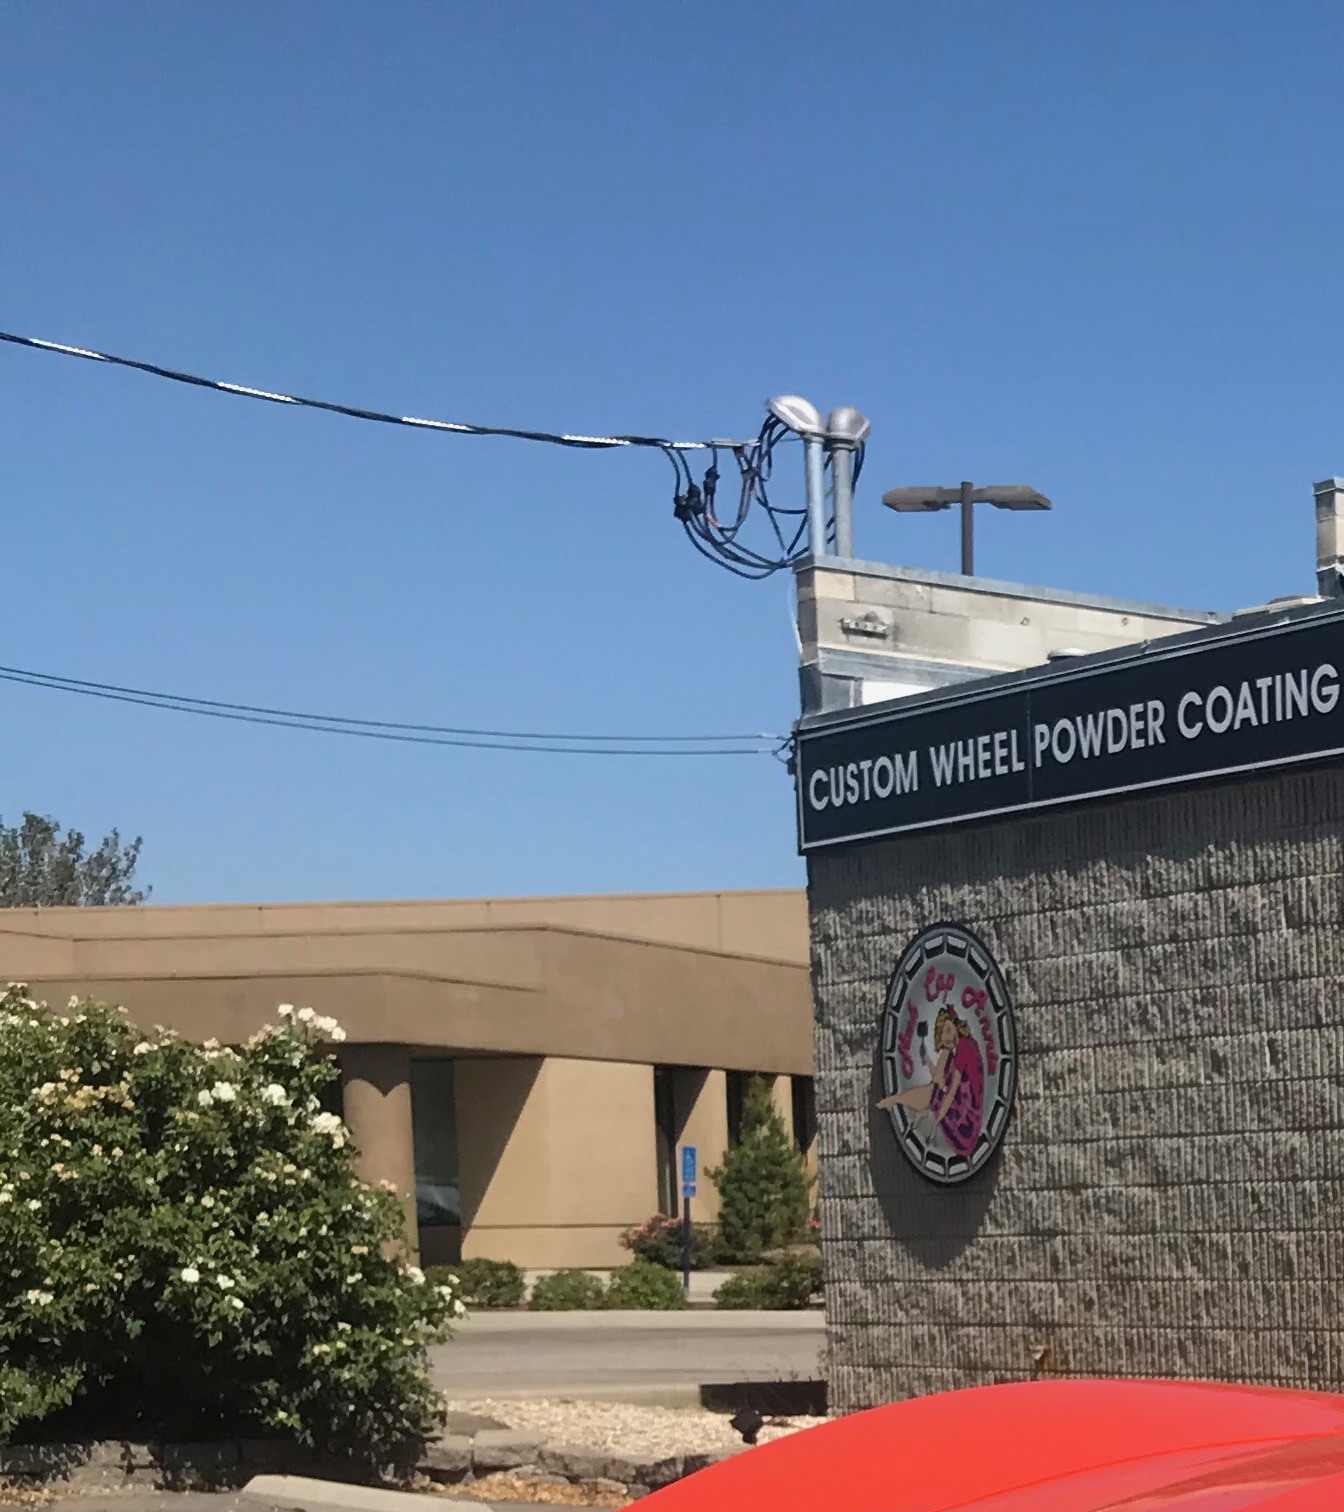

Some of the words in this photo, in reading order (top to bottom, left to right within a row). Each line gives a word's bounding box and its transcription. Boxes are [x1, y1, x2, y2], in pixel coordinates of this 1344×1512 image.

[809, 749, 919, 811] CUSTOM
[930, 729, 1025, 787] WHEEL
[1034, 700, 1166, 768] POWDER
[1177, 663, 1341, 740] COATING
